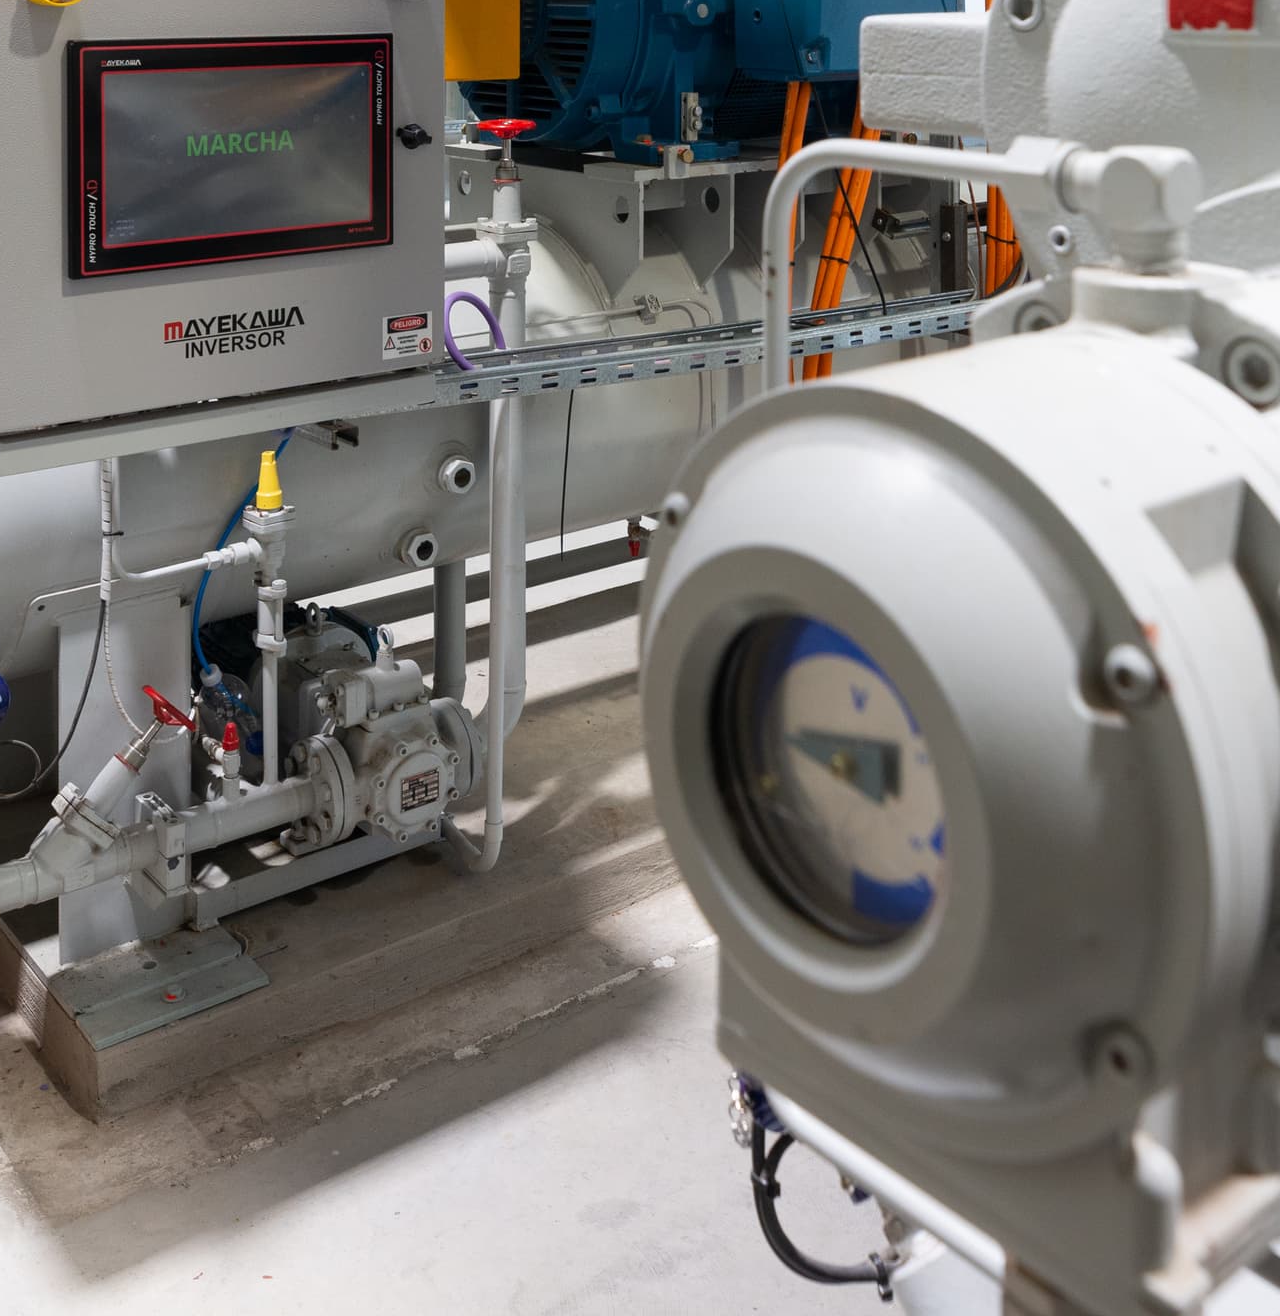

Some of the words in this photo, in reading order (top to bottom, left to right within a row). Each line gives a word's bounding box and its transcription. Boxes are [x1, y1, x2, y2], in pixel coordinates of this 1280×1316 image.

[186, 130, 294, 157] MARCHA
[88, 202, 97, 231] TOUCH
[88, 232, 97, 263] MYPRO
[164, 306, 305, 341] MAYEKAWA
[185, 330, 286, 359] INVERSOR
